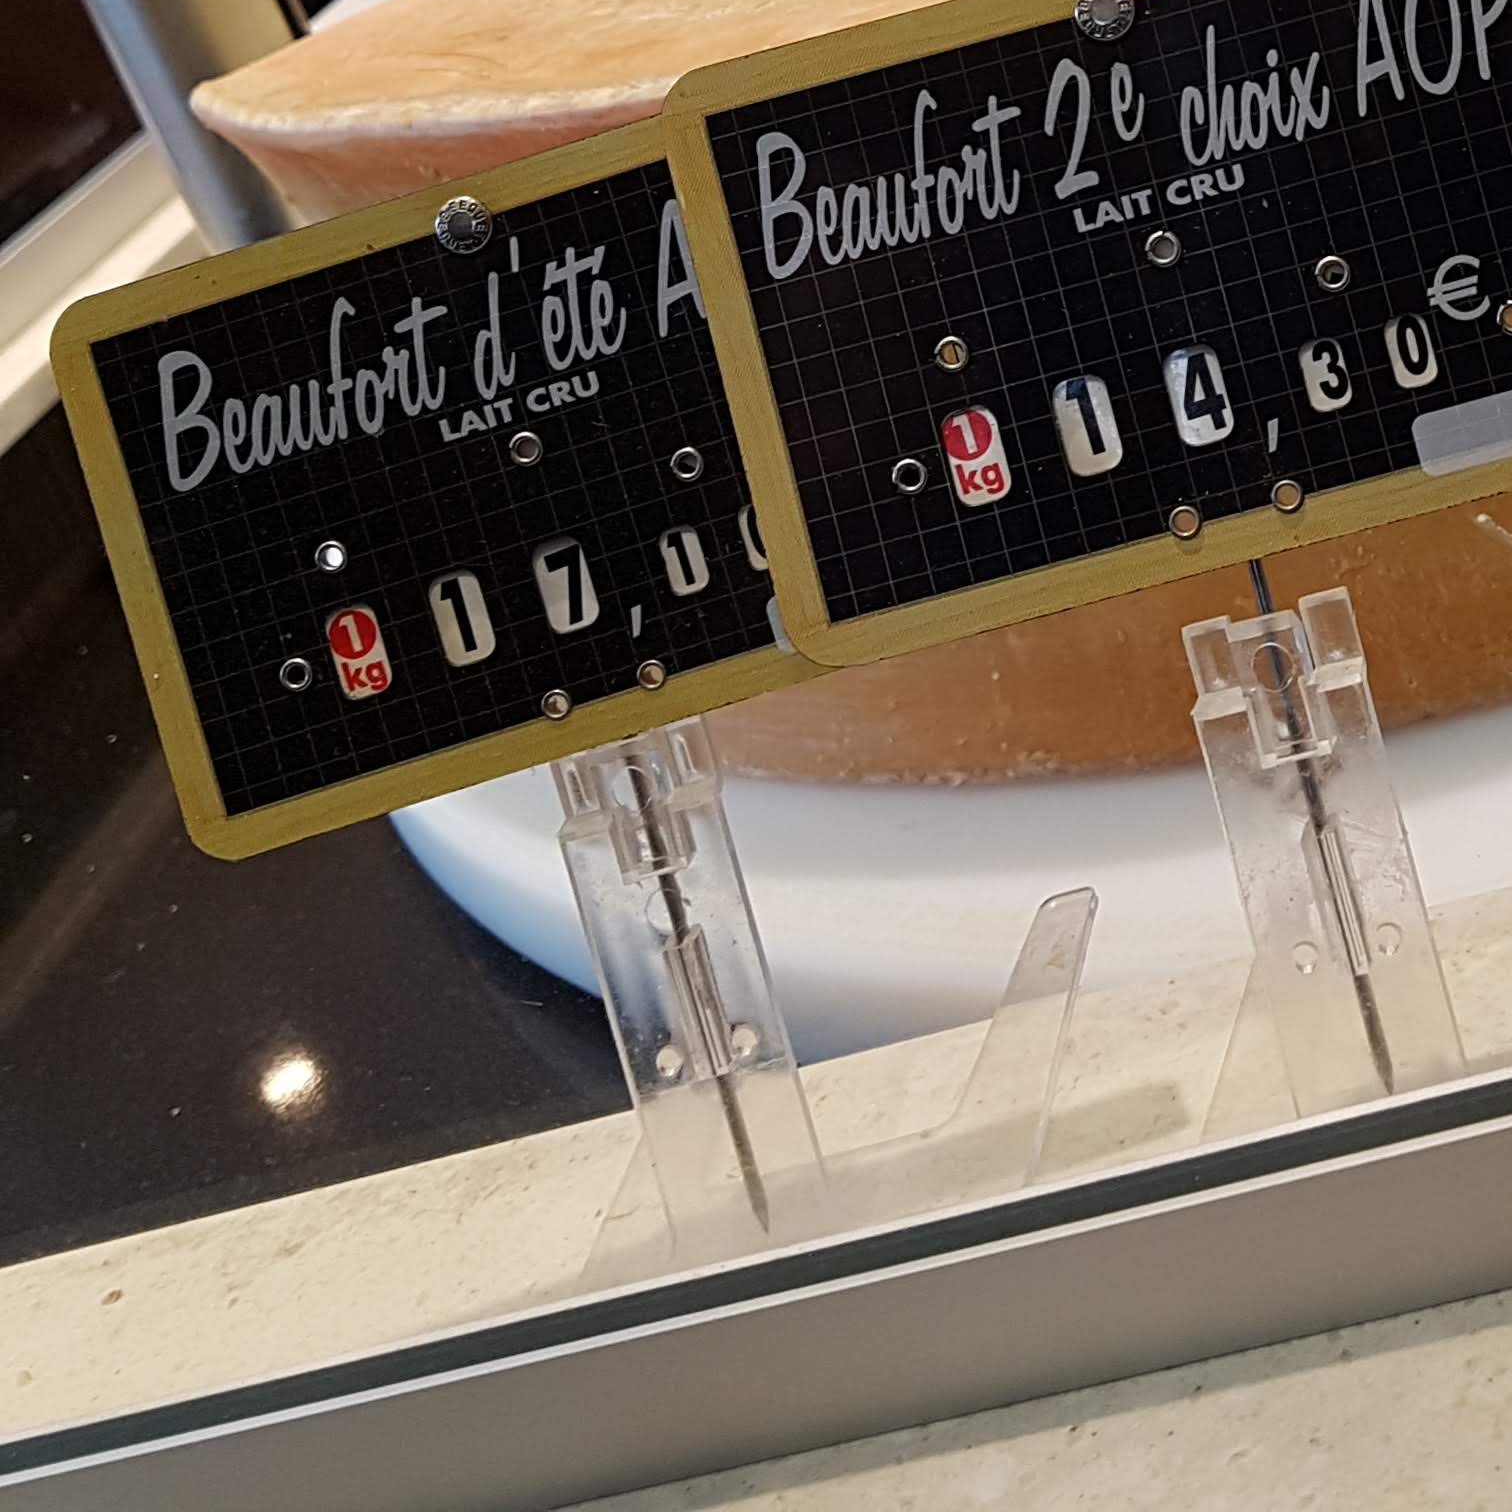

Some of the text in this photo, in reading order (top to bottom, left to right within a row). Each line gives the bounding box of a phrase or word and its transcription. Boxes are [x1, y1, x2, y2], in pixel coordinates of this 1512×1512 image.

[756, 89, 1021, 279] Beaufort
[1180, 24, 1330, 166] choix
[1073, 164, 1245, 233] LAIT CRU
[158, 297, 448, 492] Beaufort
[438, 371, 599, 442] LAIT CRU
[954, 463, 1005, 495] kg
[341, 660, 389, 692] kg
